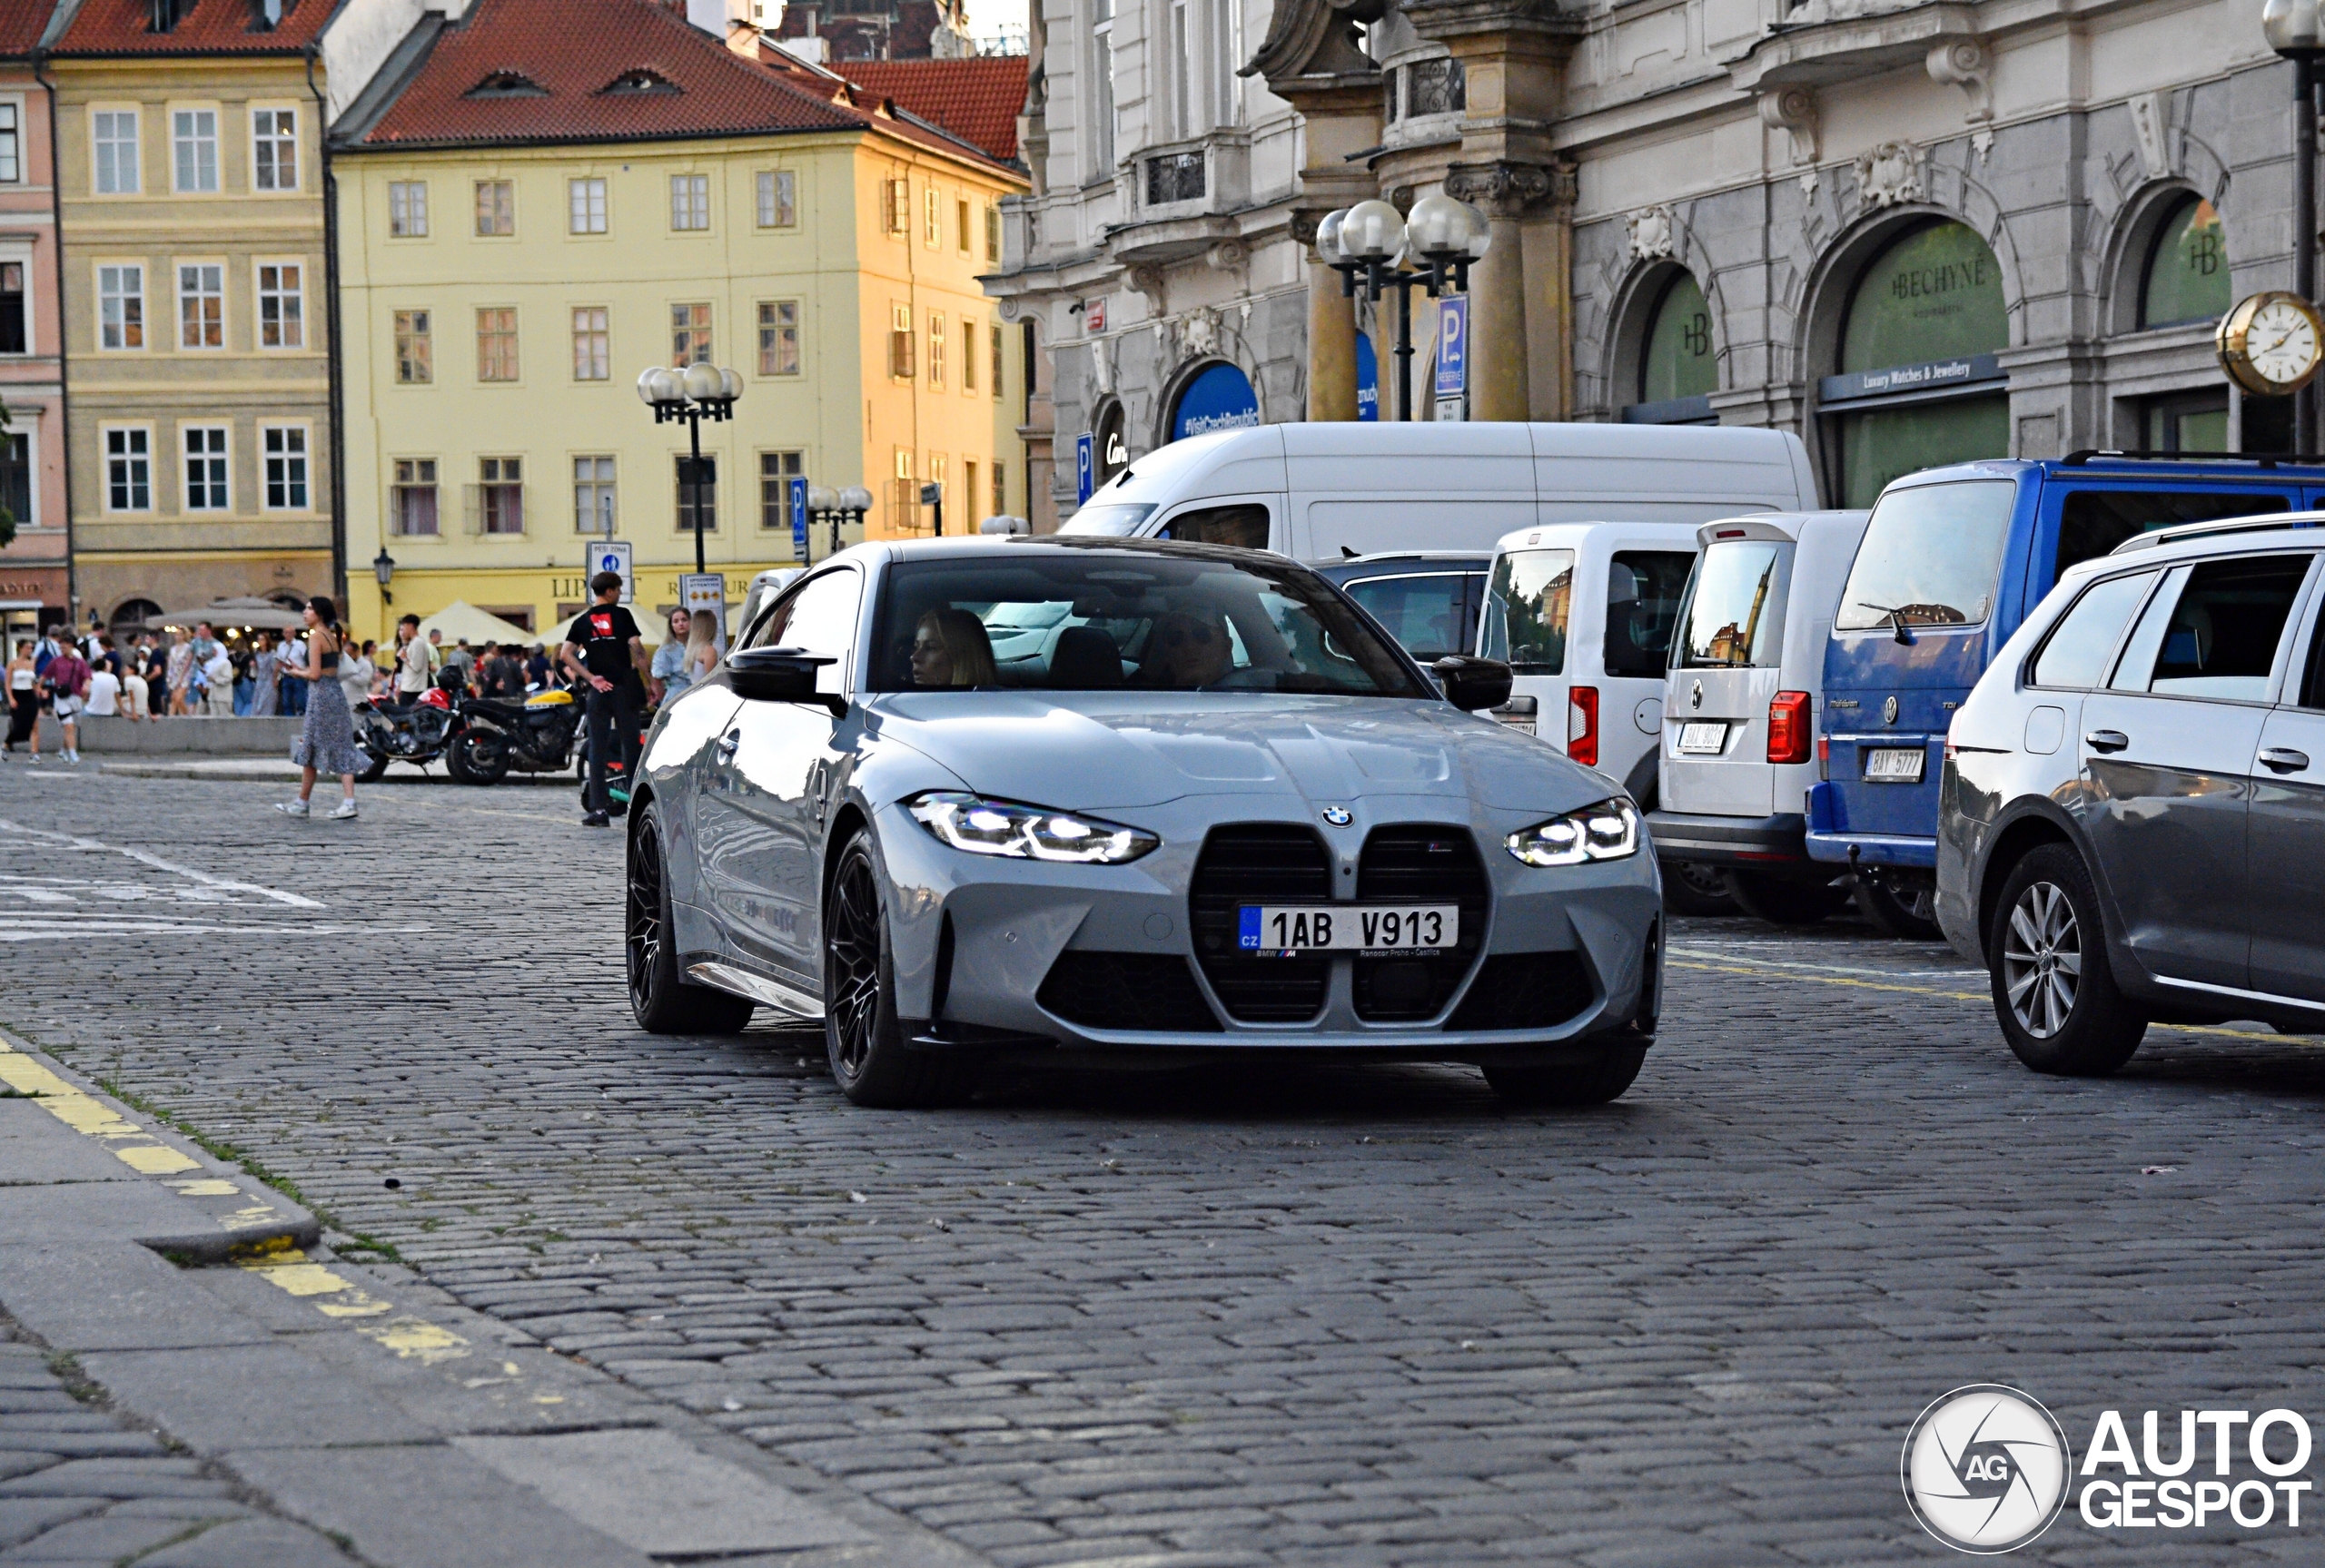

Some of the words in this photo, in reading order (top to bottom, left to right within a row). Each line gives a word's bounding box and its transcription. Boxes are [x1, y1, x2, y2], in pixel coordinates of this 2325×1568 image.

[1865, 375, 1889, 390] Luxury
[1891, 369, 1923, 385] Watches
[1924, 366, 1931, 380] &
[1934, 361, 1971, 380] Jewellery
[1874, 752, 1893, 773] 8AY
[1895, 752, 1921, 773] 5777
[1242, 936, 1258, 946] CZ
[1272, 912, 1332, 947] 1AB
[1361, 911, 1442, 947] V913
